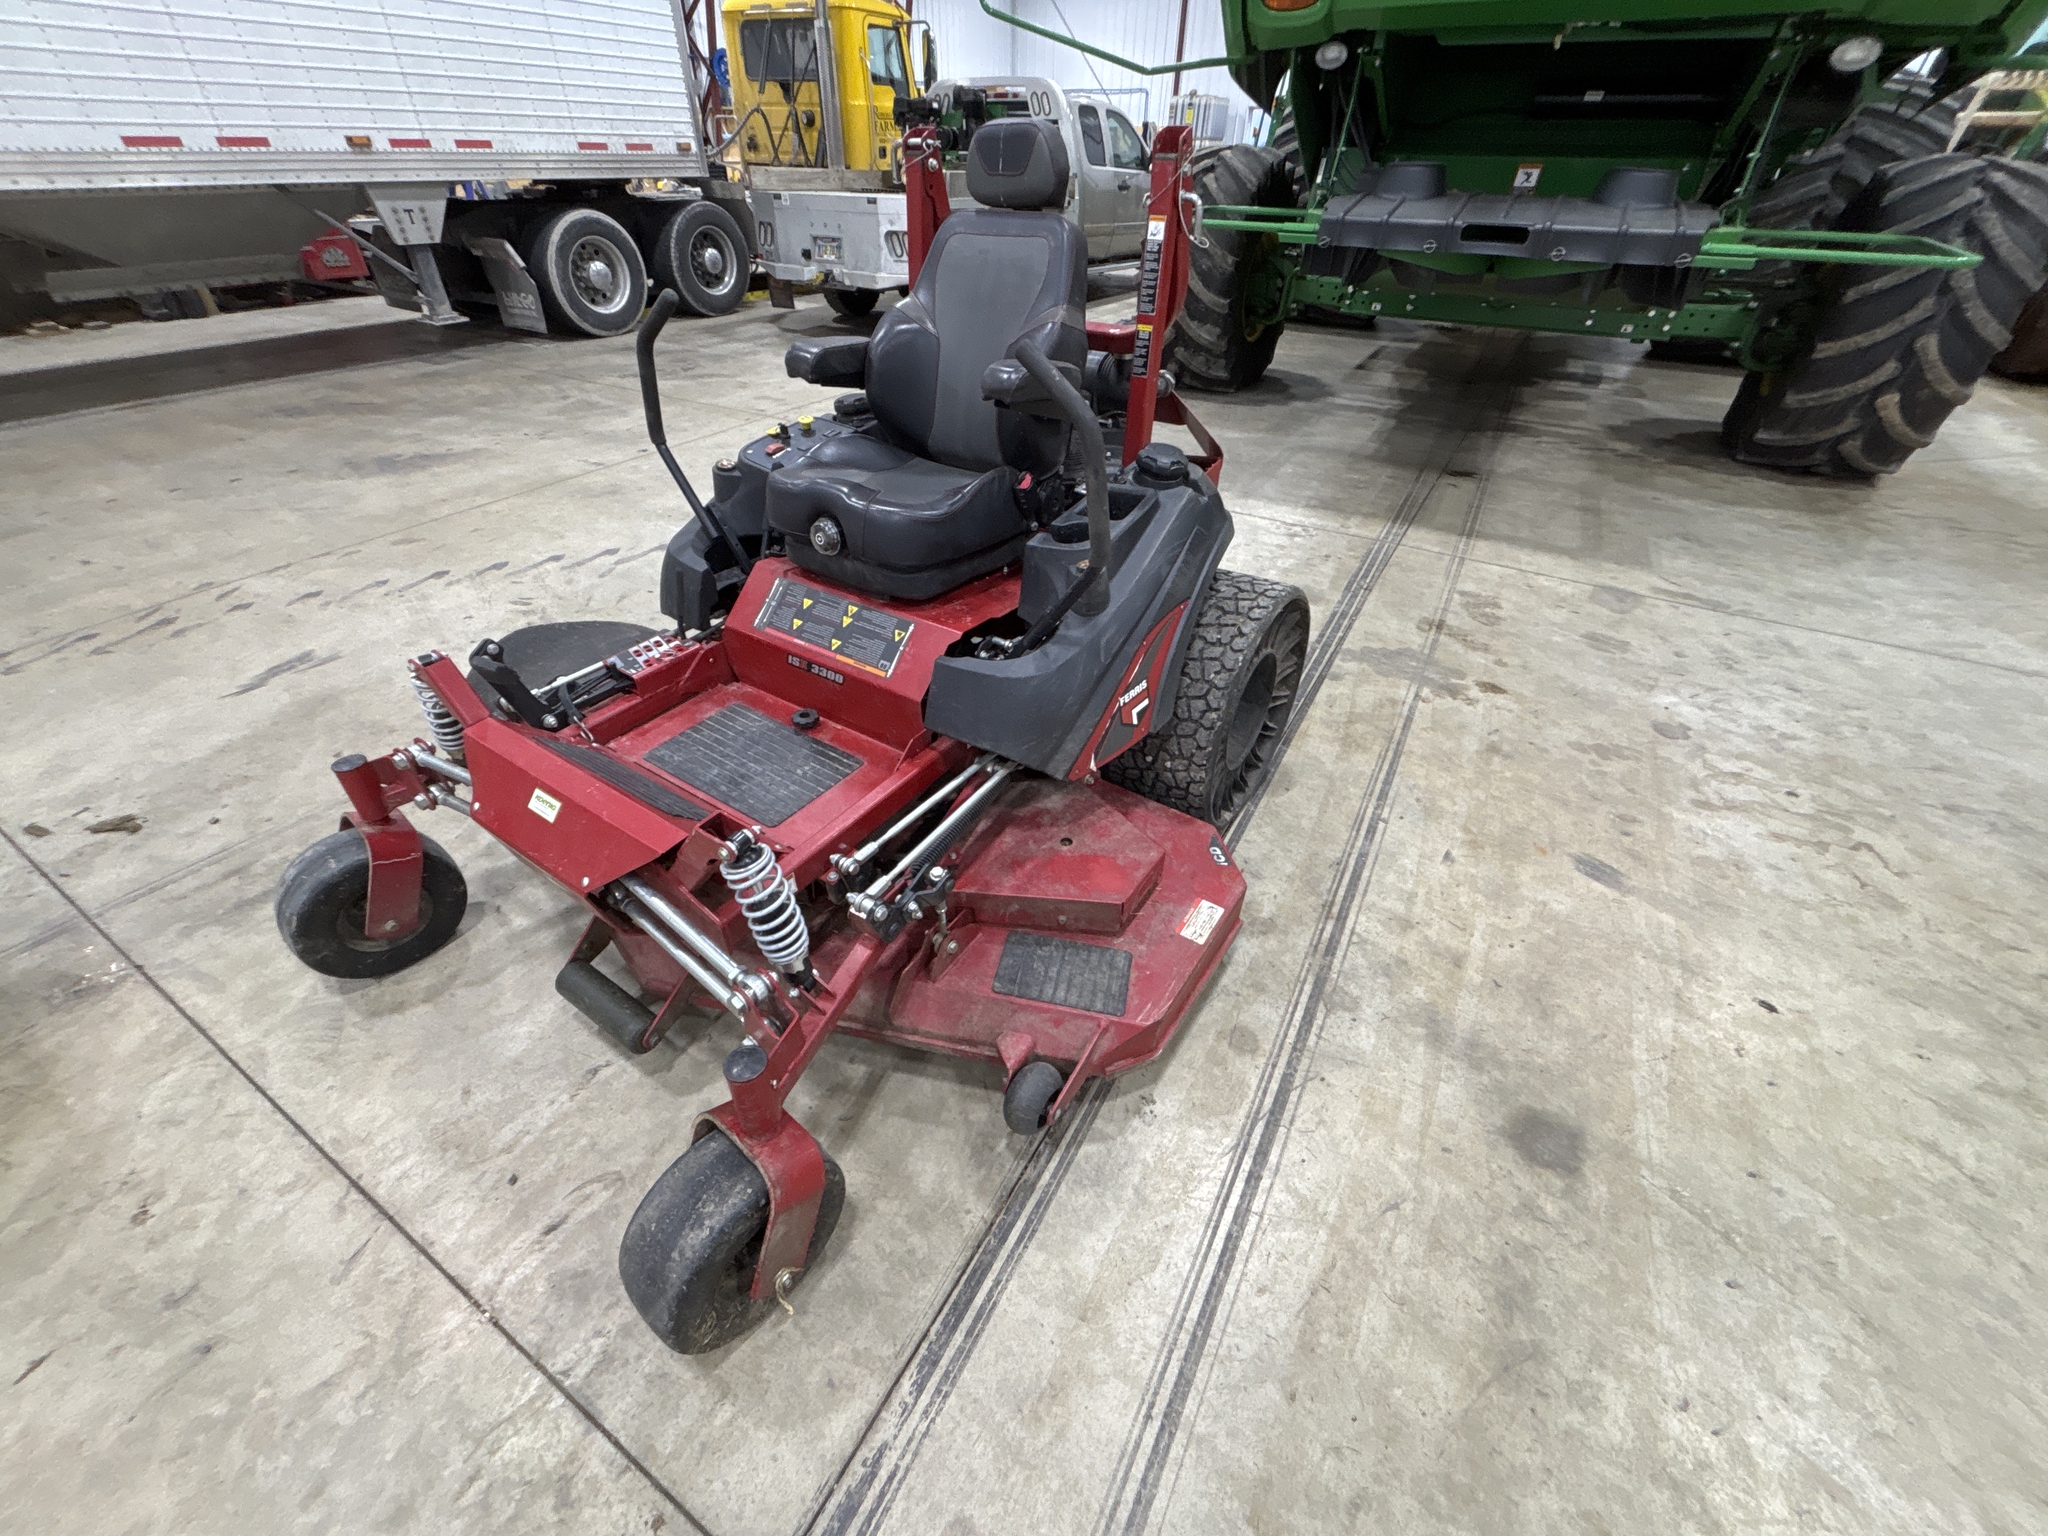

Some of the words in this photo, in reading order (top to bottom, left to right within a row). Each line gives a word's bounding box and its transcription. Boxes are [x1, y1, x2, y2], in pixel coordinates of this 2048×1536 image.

[403, 208, 415, 224] T
[811, 663, 844, 684] 3300
[1119, 679, 1147, 707] FERRIS
